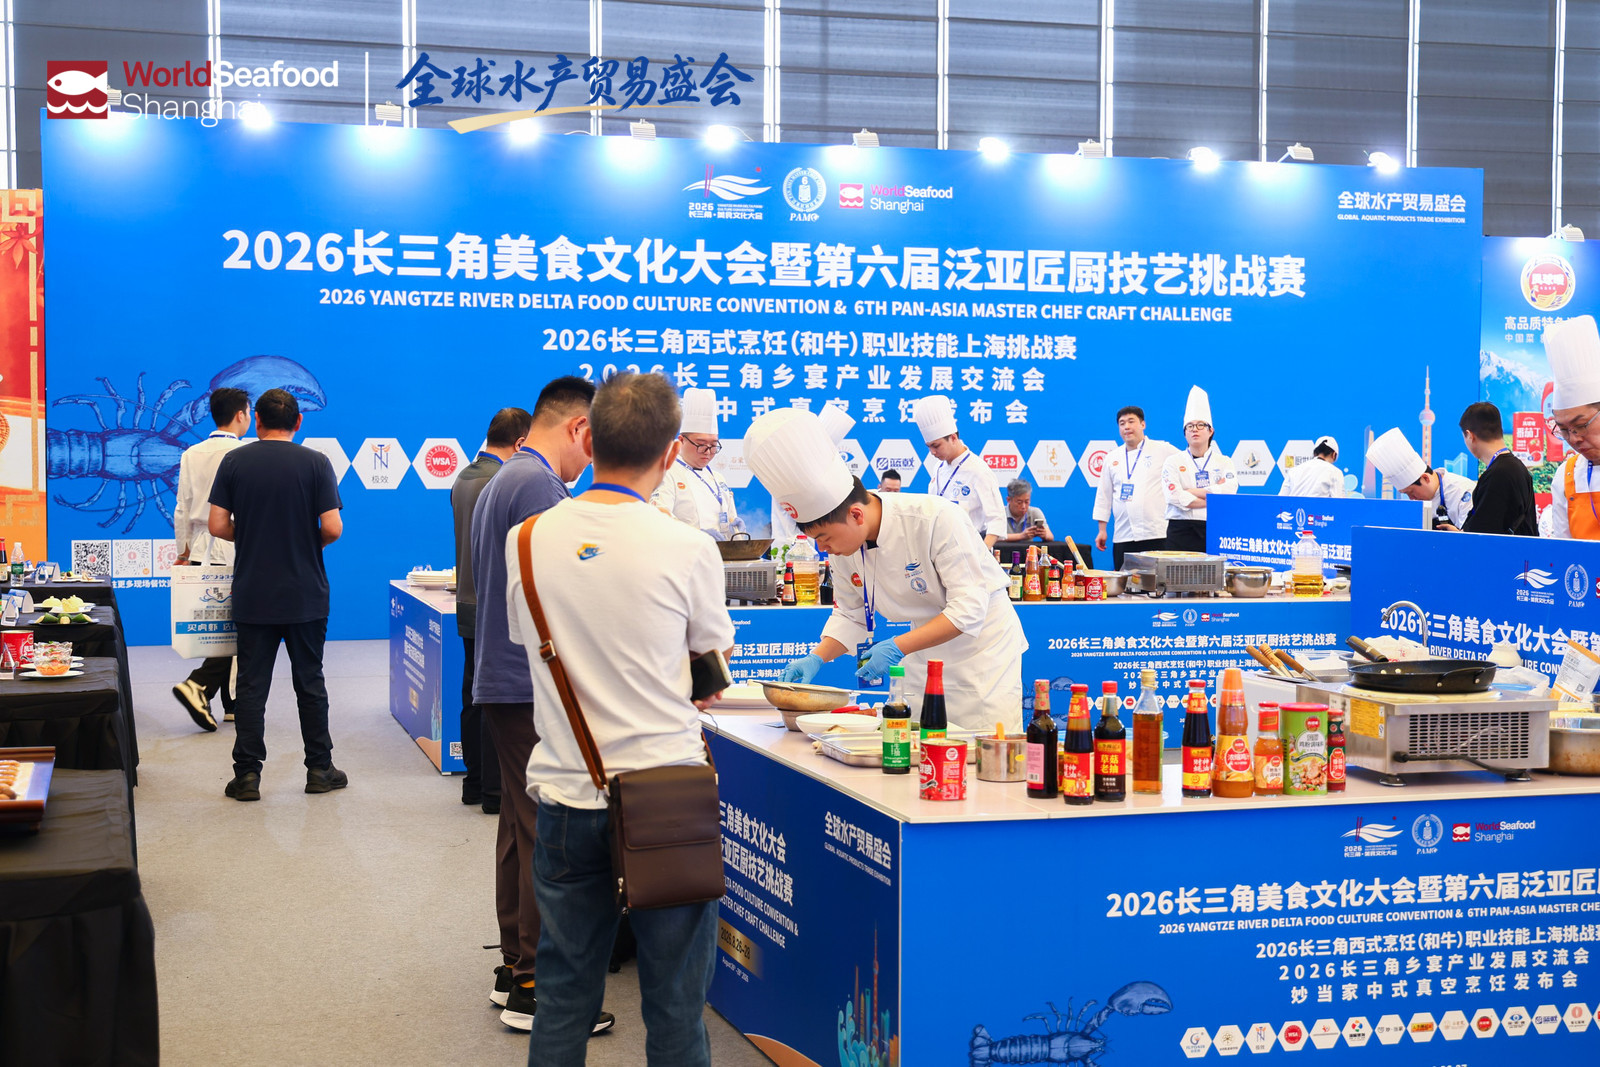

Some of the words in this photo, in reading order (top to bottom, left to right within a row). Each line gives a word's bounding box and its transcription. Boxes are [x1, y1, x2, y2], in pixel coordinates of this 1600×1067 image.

[688, 202, 714, 211] 2026
[870, 198, 924, 214] Shanghai
[1337, 191, 1466, 213] 全球水产贸易盛会
[1337, 213, 1359, 221] GLOBAL
[1361, 214, 1386, 222] AQUATIC
[1387, 215, 1416, 223] PRODUCTS
[222, 228, 1306, 298] 2026长三角美食文化大会暨第六届泛亚匠厨技艺挑战赛
[319, 288, 365, 306] 2026
[369, 289, 454, 307] YANGTZE
[459, 291, 514, 309] RIVER
[518, 293, 573, 310] DELTA
[577, 294, 628, 311] FOOD
[632, 295, 712, 313] CULTURE
[716, 297, 830, 315] CONVENTION
[833, 300, 847, 316] &
[853, 299, 896, 316] 6TH
[900, 301, 969, 318] PAN-ASIA
[972, 303, 1037, 319] MASTER
[1040, 304, 1083, 320] CHEF
[1086, 305, 1136, 321] CRAFT
[1140, 306, 1232, 322] CHALLENGE
[542, 326, 1078, 361] 2026长三角西式烹饪(和牛)职业技能上海挑战赛
[432, 457, 451, 466] WSA
[1430, 645, 1452, 658] RIVER
[1453, 647, 1477, 660] DELTA
[825, 811, 892, 870] 全球水产贸易盛会
[1474, 832, 1514, 844] Shanghai
[720, 833, 793, 907] 亚匠厨技艺挑战赛
[1106, 867, 1600, 917] 2026长三角美食文化大会暨第六届泛亚匠
[1159, 923, 1186, 935] 2026
[1187, 920, 1235, 933] YANGTZE
[1237, 918, 1269, 930] RIVER
[1271, 916, 1304, 928] DELTA
[1305, 914, 1335, 926] FOOD
[1337, 911, 1383, 925] CULTURE
[1386, 908, 1454, 922] CONVENTION
[1455, 909, 1463, 918] &
[1467, 907, 1488, 918] 6TH
[1490, 905, 1537, 917] PAN-ASIA
[1538, 902, 1579, 915] MASTER
[1580, 901, 1600, 911] CHE
[1279, 946, 1589, 981] 2026长三角乡宴产业发展交流会
[1291, 970, 1578, 1004] 妙当家中式真空烹饪发布会
